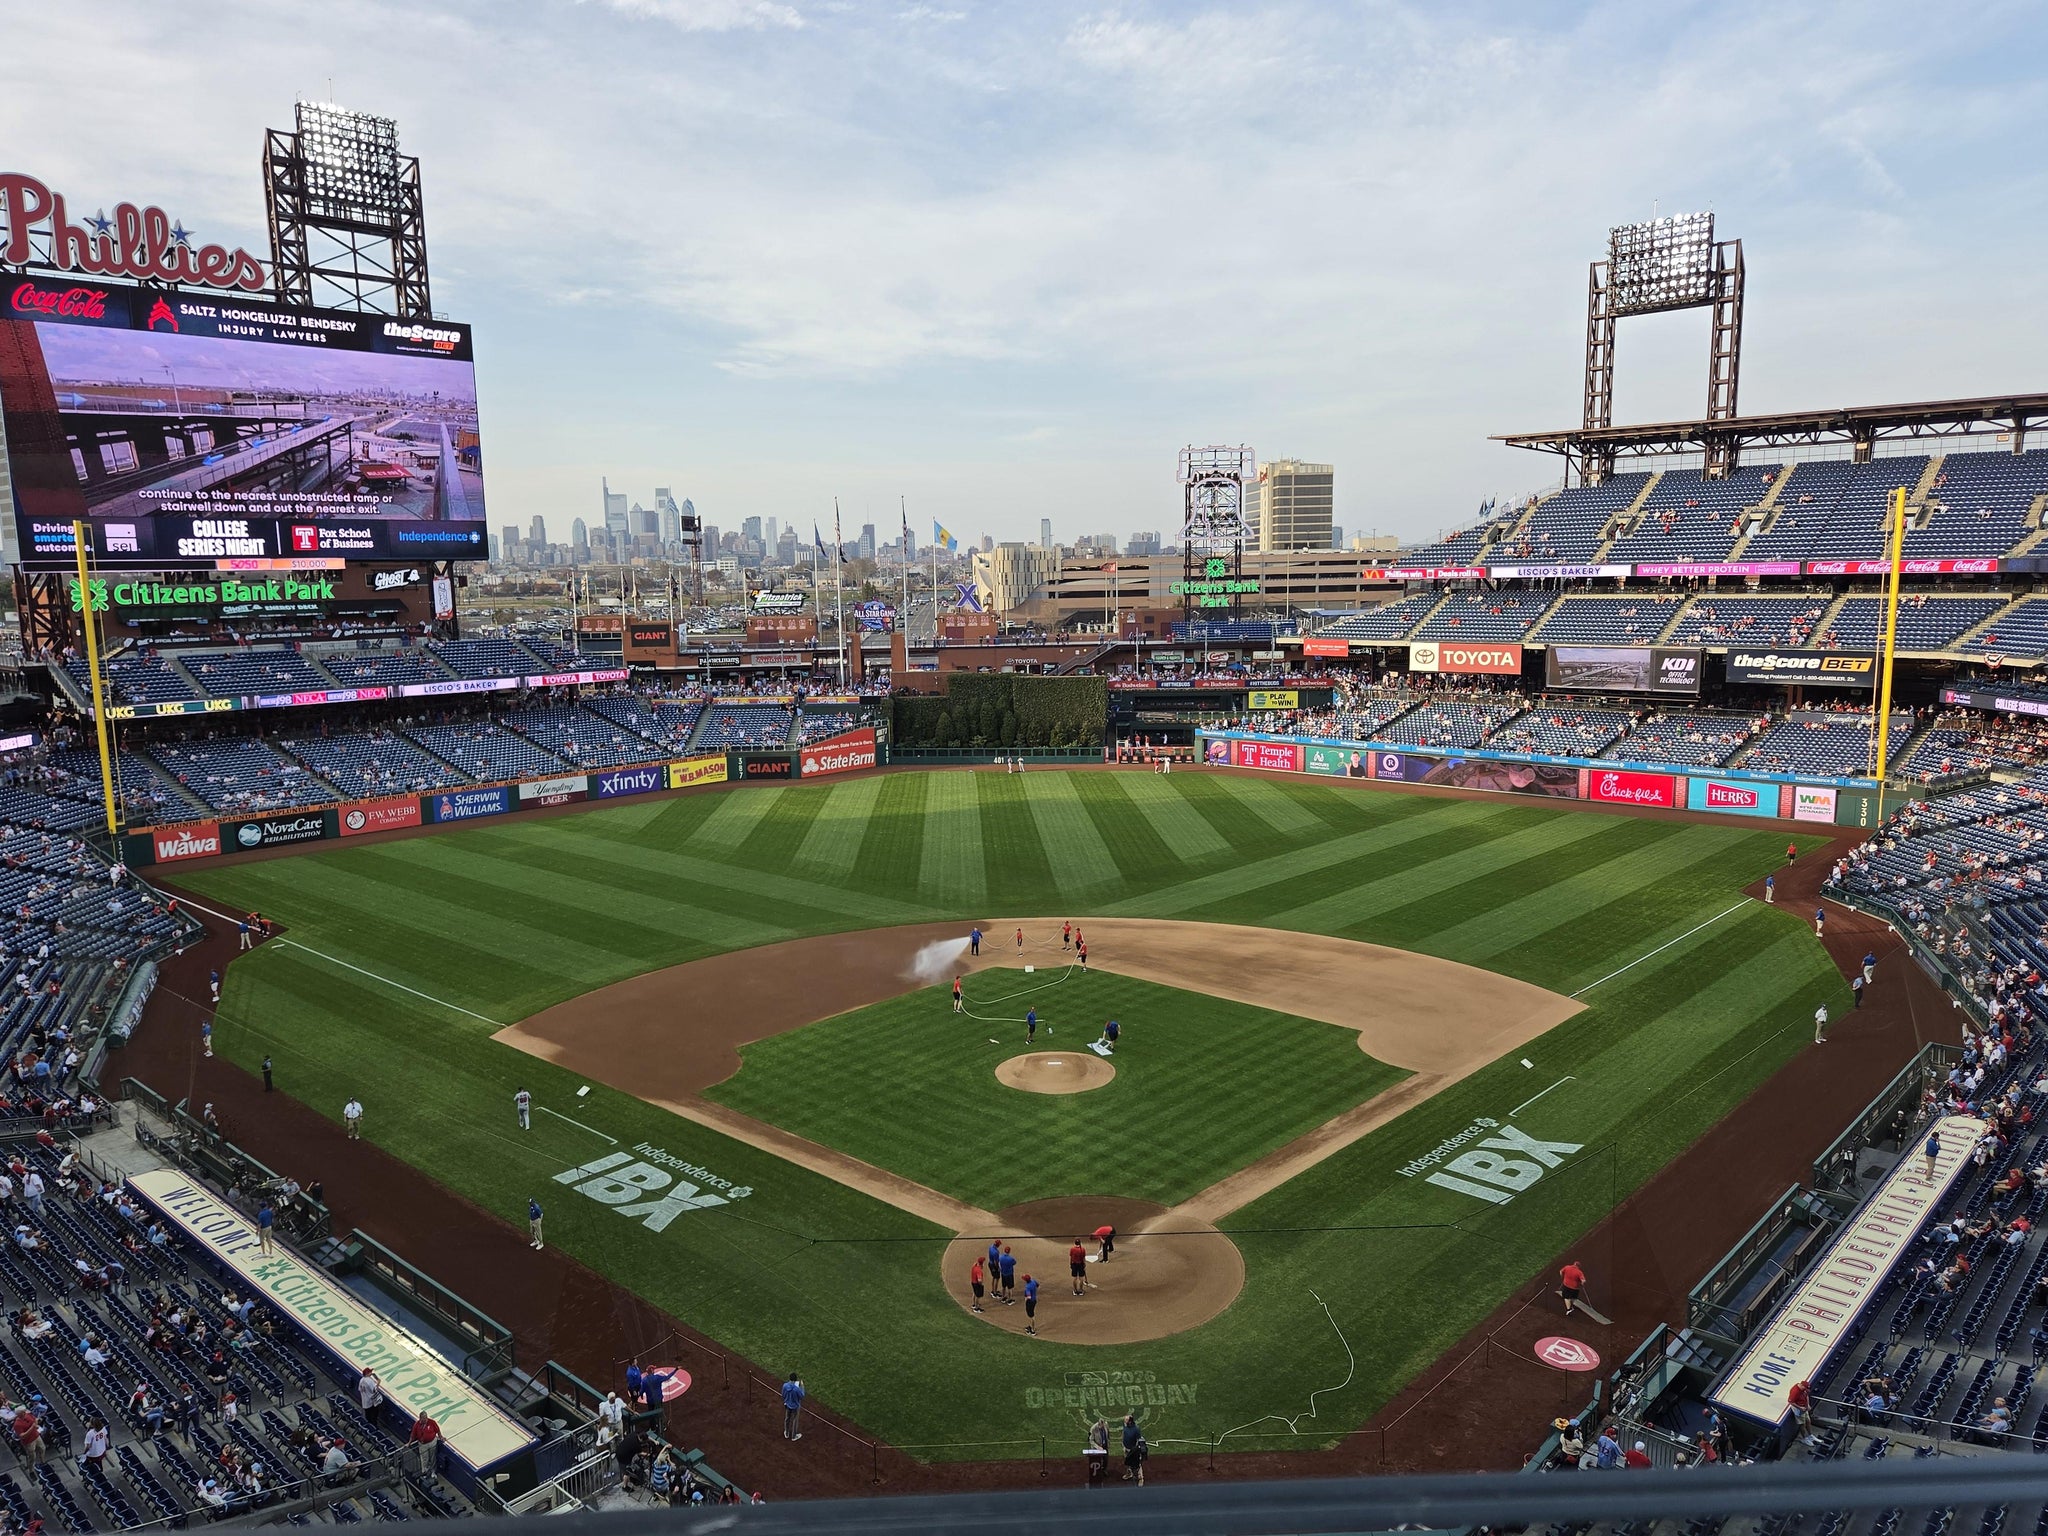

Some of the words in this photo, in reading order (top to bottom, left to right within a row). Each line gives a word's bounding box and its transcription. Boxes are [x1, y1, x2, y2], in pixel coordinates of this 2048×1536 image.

[0, 172, 267, 292] Phillies
[11, 283, 109, 319] Coca-Cola
[180, 304, 217, 317] SALTZ
[221, 308, 297, 326] MONGELUZZI
[300, 317, 357, 332] BENDESKY
[218, 324, 264, 336] INJURY
[273, 329, 327, 343] LAWYERS
[383, 322, 461, 342] theScore
[138, 489, 193, 500] continue
[195, 490, 208, 500] to
[210, 490, 231, 500] the
[234, 491, 277, 501] nearest
[279, 492, 351, 503] unobstructed
[353, 494, 380, 505] ramp
[382, 495, 393, 503] or
[161, 501, 211, 511] stairwell
[214, 502, 246, 512] down
[248, 502, 271, 513] and
[273, 504, 293, 513] out
[294, 503, 313, 513] the
[316, 504, 356, 514] nearest
[357, 504, 380, 514] exit.
[192, 520, 249, 538] COLLEGE
[319, 528, 338, 539] Fox
[339, 528, 371, 539] School
[399, 531, 468, 543] Independence
[178, 538, 224, 556] SERIES
[225, 538, 266, 556] NIGHT
[320, 538, 331, 549] of
[332, 538, 374, 549] Business
[291, 559, 327, 569] $10,000
[1672, 566, 1705, 574] BETTER
[1708, 565, 1750, 574] PROTEIN
[1813, 562, 1848, 573] Coca-Cola
[1905, 561, 1941, 572] Coca-Cola
[1953, 560, 1990, 572] Coca-Cola
[1518, 568, 1558, 576] LISCIO'S
[1561, 567, 1601, 575] BAKERY
[375, 569, 411, 589] GHOST
[114, 581, 217, 605] Citizens
[220, 579, 281, 602] Bank
[284, 578, 335, 600] Park
[1170, 580, 1223, 595] Citizens
[1225, 579, 1260, 593] Bank
[757, 590, 804, 602] Fitzpatrick
[1200, 594, 1230, 607] Park
[880, 609, 897, 617] GAME
[634, 632, 667, 640] GIANT
[1443, 651, 1515, 666] TOYOTA
[1661, 658, 1696, 671] KDI
[1733, 654, 1821, 669] theScore
[1826, 660, 1867, 669] BET
[545, 675, 578, 684] TOYOTA
[594, 671, 626, 680] TOYOTA
[1660, 677, 1696, 685] TECHNOLOGY
[423, 682, 462, 693] LISCIO'S
[464, 680, 498, 691] BAKERY
[295, 694, 325, 704] NECA
[359, 688, 387, 699] NECA
[155, 703, 185, 714] UKG
[204, 699, 232, 711] UKG
[105, 707, 135, 719] UKG
[1260, 746, 1293, 758] Temple
[820, 756, 849, 771] State
[849, 752, 875, 767] Farm
[1260, 757, 1291, 768] Health
[585, 767, 617, 776] ASPLUNDH
[747, 763, 791, 773] GIANT
[504, 776, 539, 786] ASPLUNDH
[546, 772, 579, 780] ASPLUNDH
[1795, 776, 1831, 784] Independence
[461, 782, 497, 792] ASPLUNDH
[533, 780, 575, 796] Yuengling
[602, 771, 657, 794] xfinity
[1600, 776, 1662, 801] Chick-fil-A
[415, 788, 454, 797] ASPLUNDH
[455, 791, 500, 806] SHERWIN
[1711, 789, 1752, 804] HERR'S
[318, 800, 360, 809] ASPLUNDH
[367, 794, 408, 804] ASPLUNDH
[541, 795, 569, 805] LAGER
[1799, 795, 1832, 805] WM
[266, 806, 310, 817] ASPLUNDH
[387, 806, 416, 818] WEBB
[1860, 798, 1868, 827] 330
[211, 813, 257, 824] ASPLUNDH
[379, 815, 405, 825] COMPANY
[154, 820, 202, 831] ASPLUNDH
[263, 818, 323, 836] NovaCare
[264, 829, 321, 843] REHABILITATION
[158, 837, 218, 858] Wawa
[1395, 1123, 1484, 1178] Independence
[632, 1141, 732, 1190] Independence
[1424, 1124, 1585, 1205] IBX
[551, 1151, 730, 1233] IBX
[160, 1186, 254, 1254] WELCOME
[1785, 1193, 1927, 1338] PHILADELPHIA
[271, 1265, 358, 1349] Citizens
[341, 1330, 417, 1383] Bank
[395, 1377, 467, 1426] Park
[1743, 1352, 1798, 1397] HOME
[1025, 1385, 1144, 1408] OPENING
[1145, 1384, 1198, 1405] DAY
